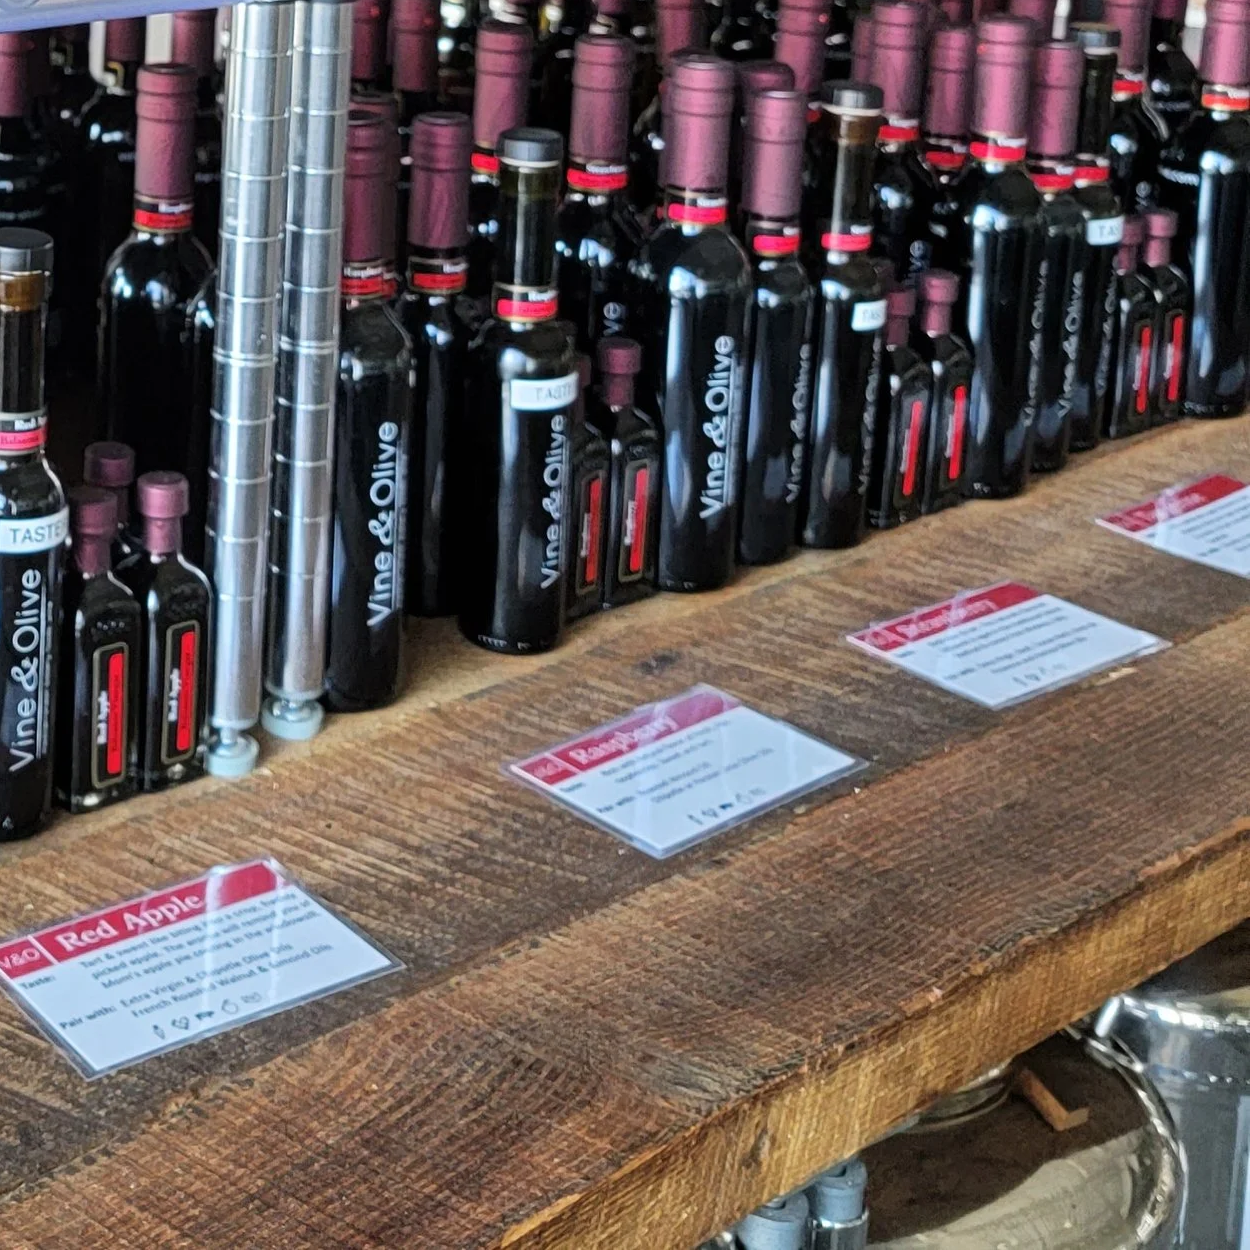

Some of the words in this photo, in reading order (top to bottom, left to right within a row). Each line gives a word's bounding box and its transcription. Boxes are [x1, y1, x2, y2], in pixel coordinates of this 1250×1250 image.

[705, 335, 734, 412] Olive
[703, 417, 726, 450] &
[700, 452, 726, 519] Vine
